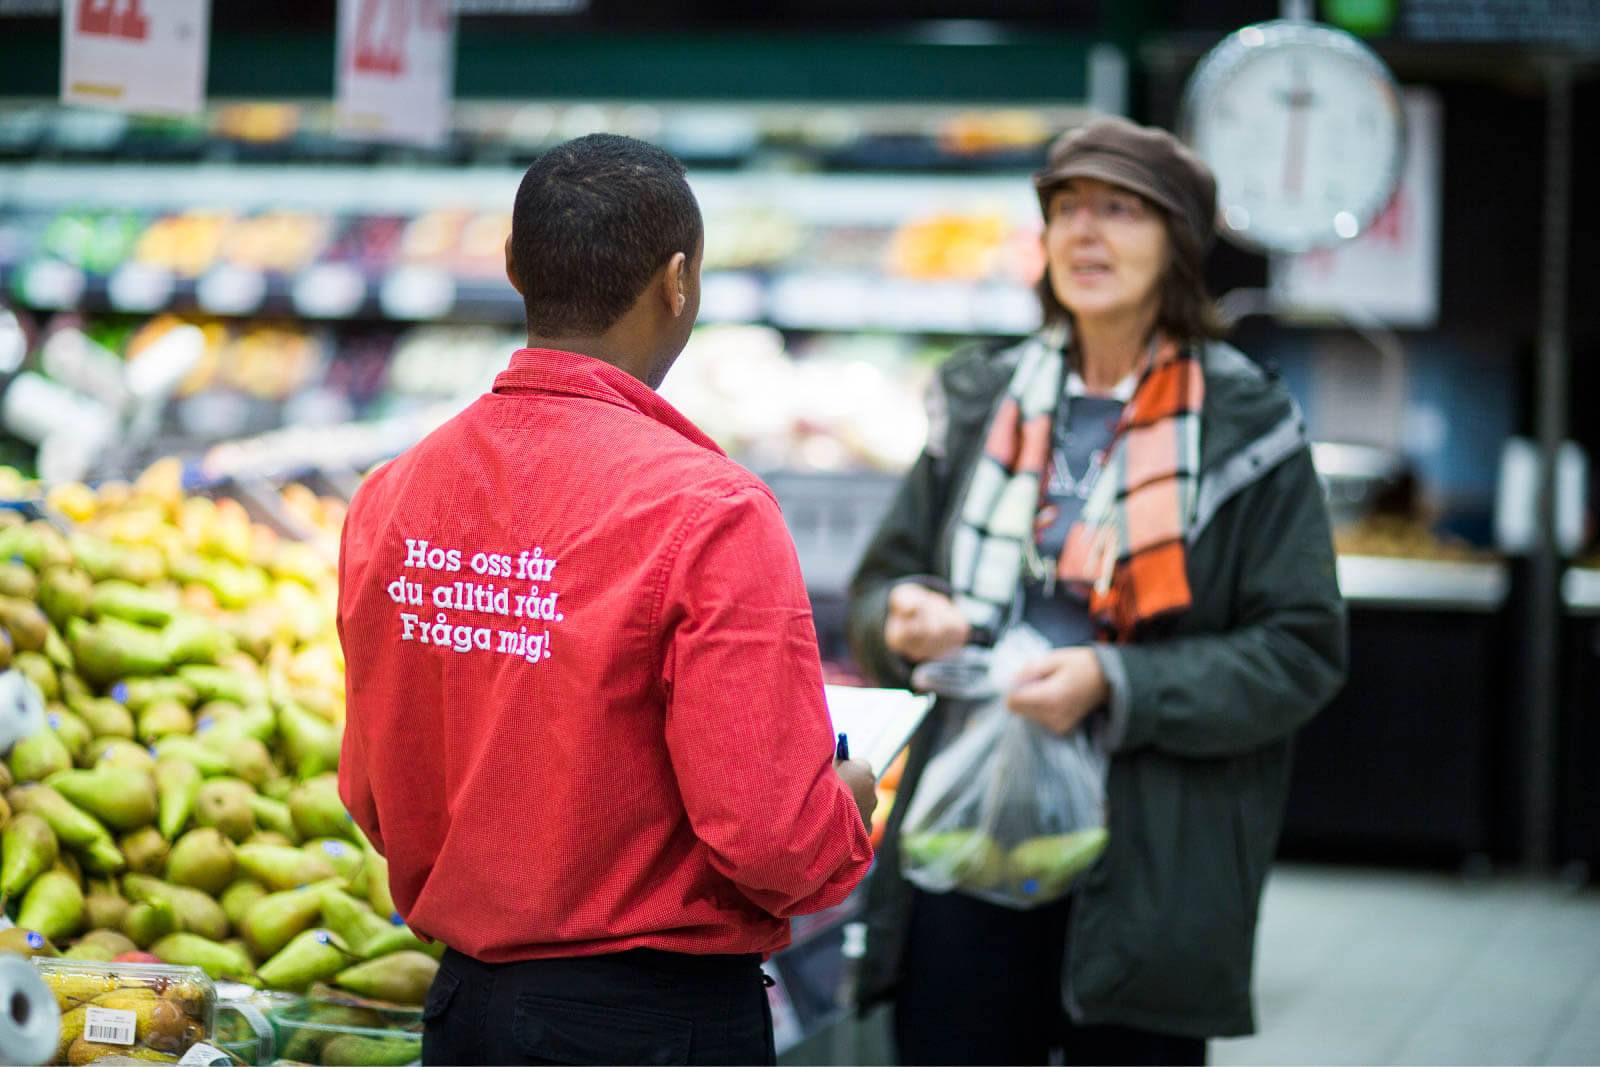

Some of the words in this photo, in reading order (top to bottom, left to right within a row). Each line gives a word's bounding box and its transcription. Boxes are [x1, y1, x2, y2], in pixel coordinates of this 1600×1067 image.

[404, 539, 461, 571] Hos
[470, 553, 512, 577] oss
[516, 548, 557, 581] får
[387, 576, 423, 605] du
[432, 582, 509, 616] alltid
[515, 586, 564, 621] råd.
[400, 613, 492, 652] Fråga
[497, 627, 551, 663] mig!
